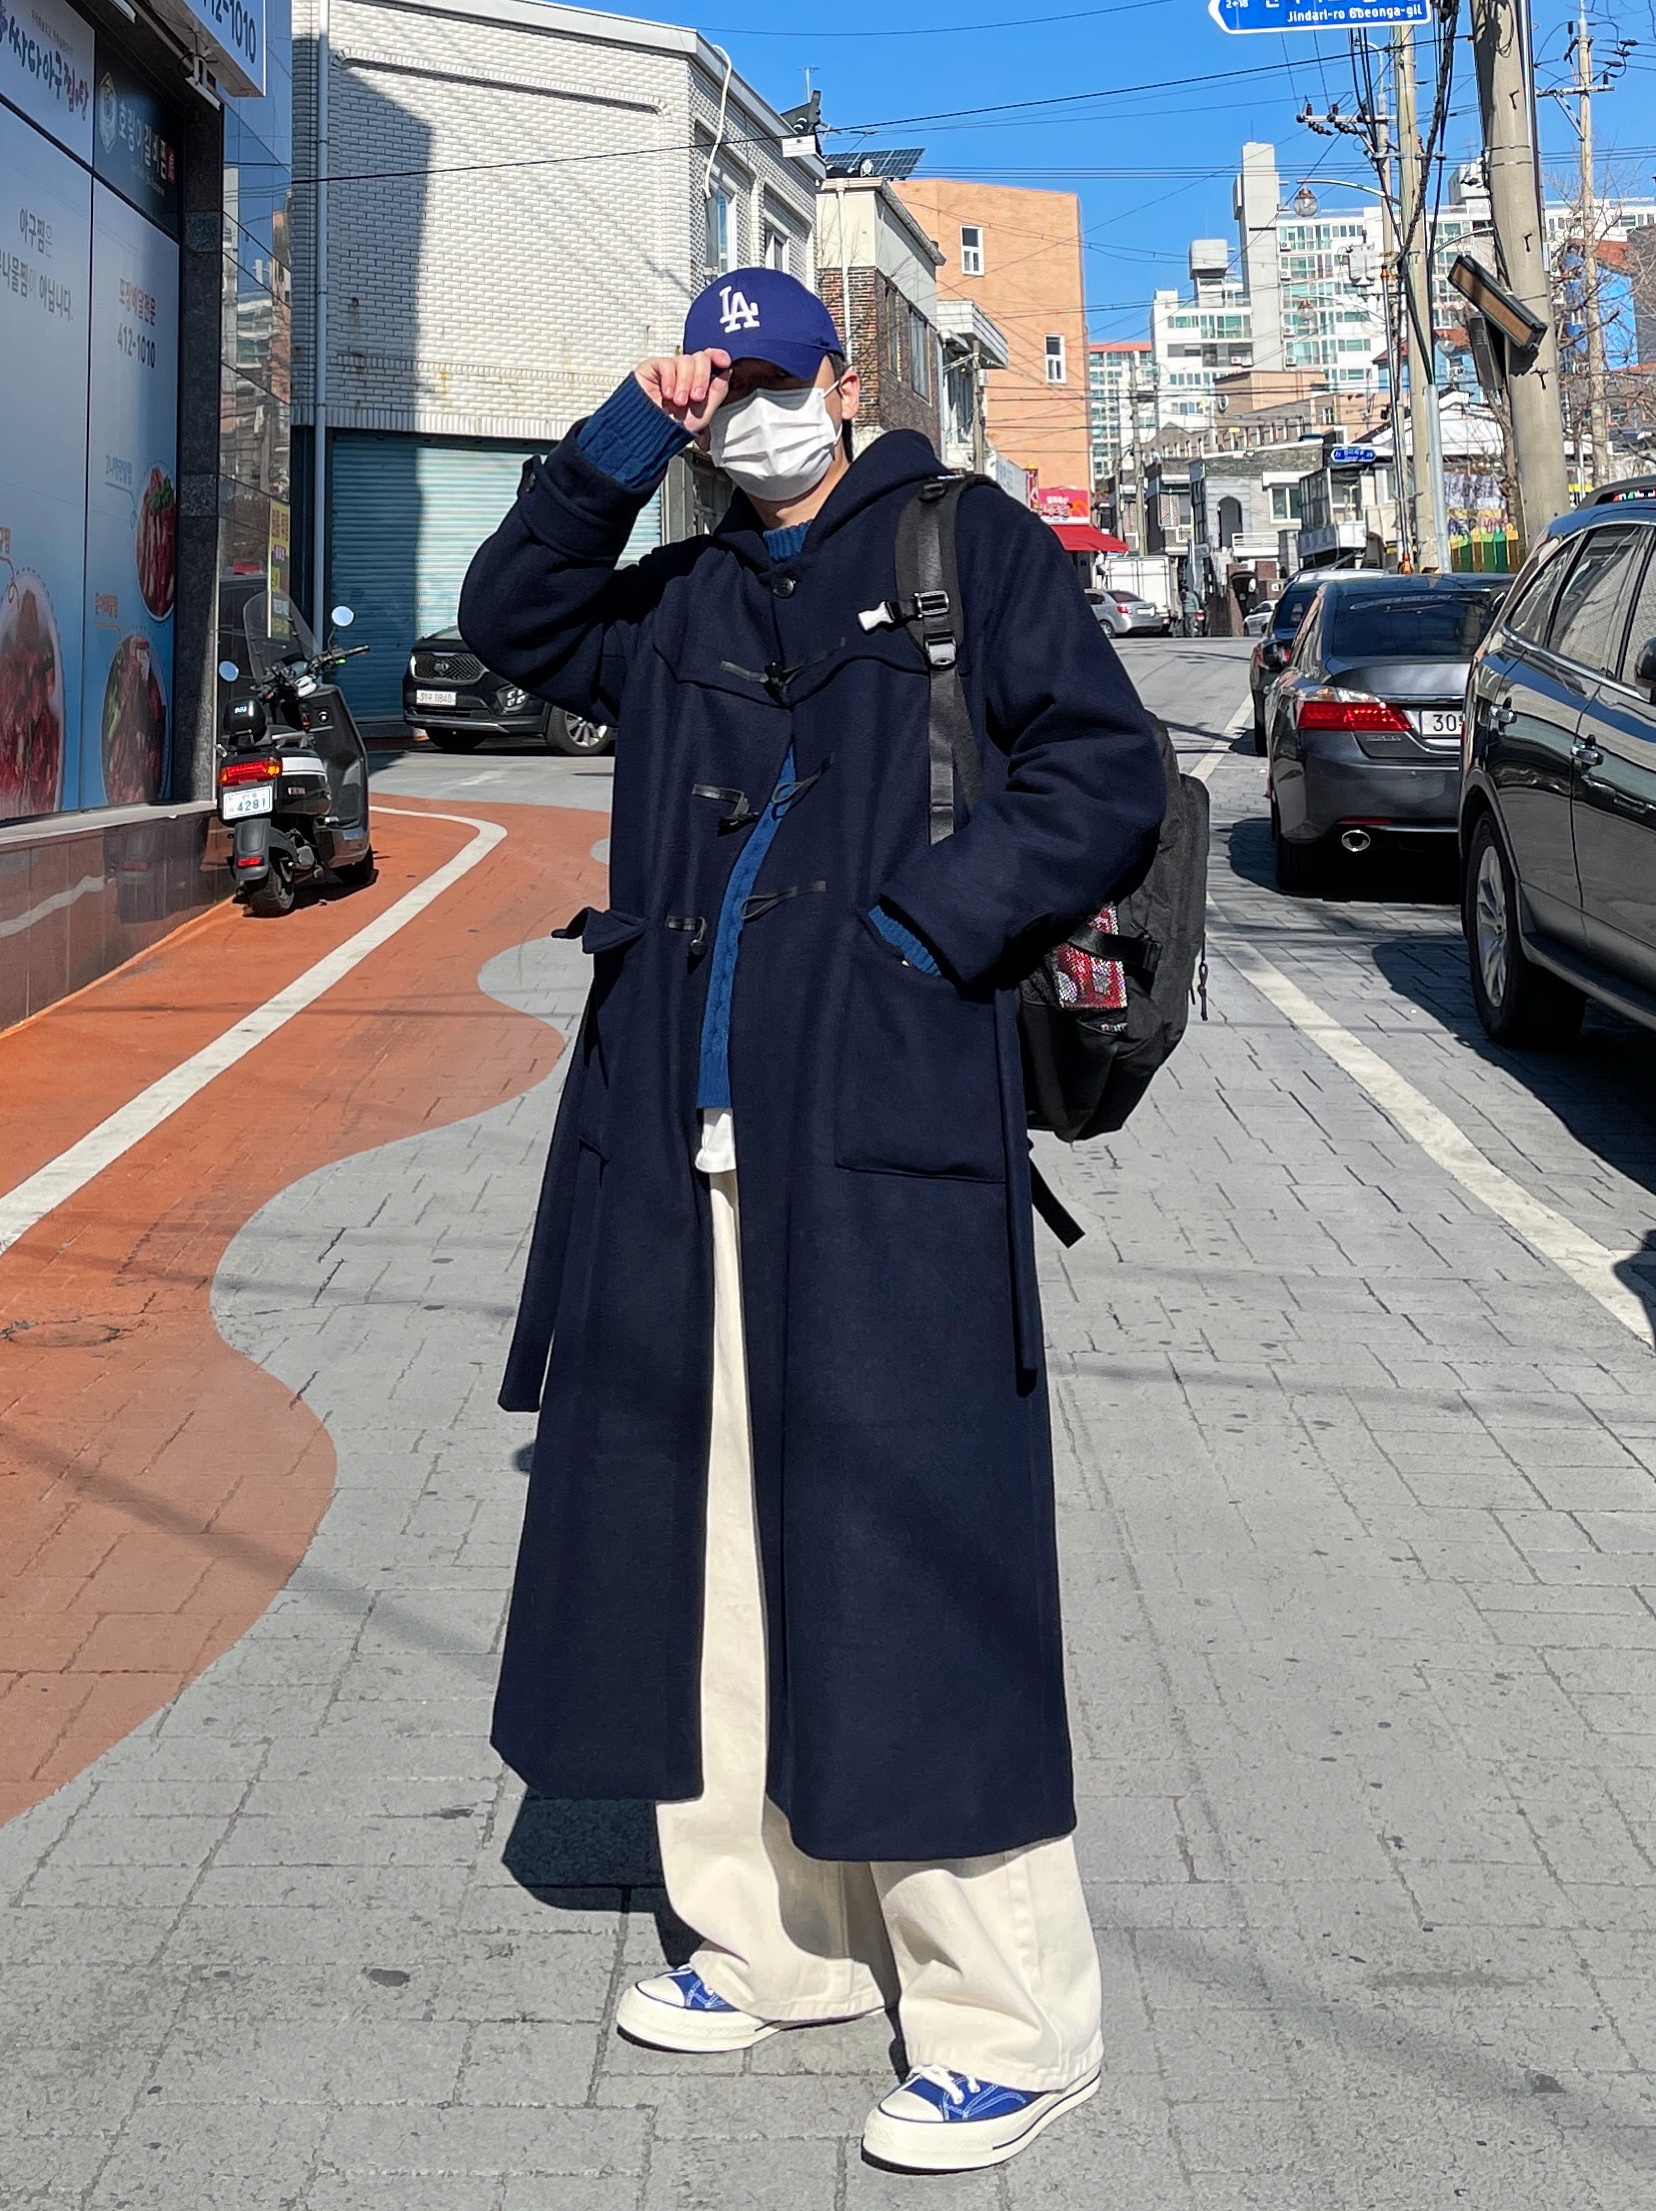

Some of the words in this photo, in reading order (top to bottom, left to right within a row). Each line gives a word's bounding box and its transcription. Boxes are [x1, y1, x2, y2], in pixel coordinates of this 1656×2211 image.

[203, 0, 256, 64] 2-1010
[1287, 8, 1345, 23] Jindari-ro
[20, 208, 53, 258] 아구찜은
[0, 249, 36, 301] 나물찜이
[719, 286, 760, 333] LA
[117, 322, 156, 369] 412-1010
[237, 798, 267, 812] 4281
